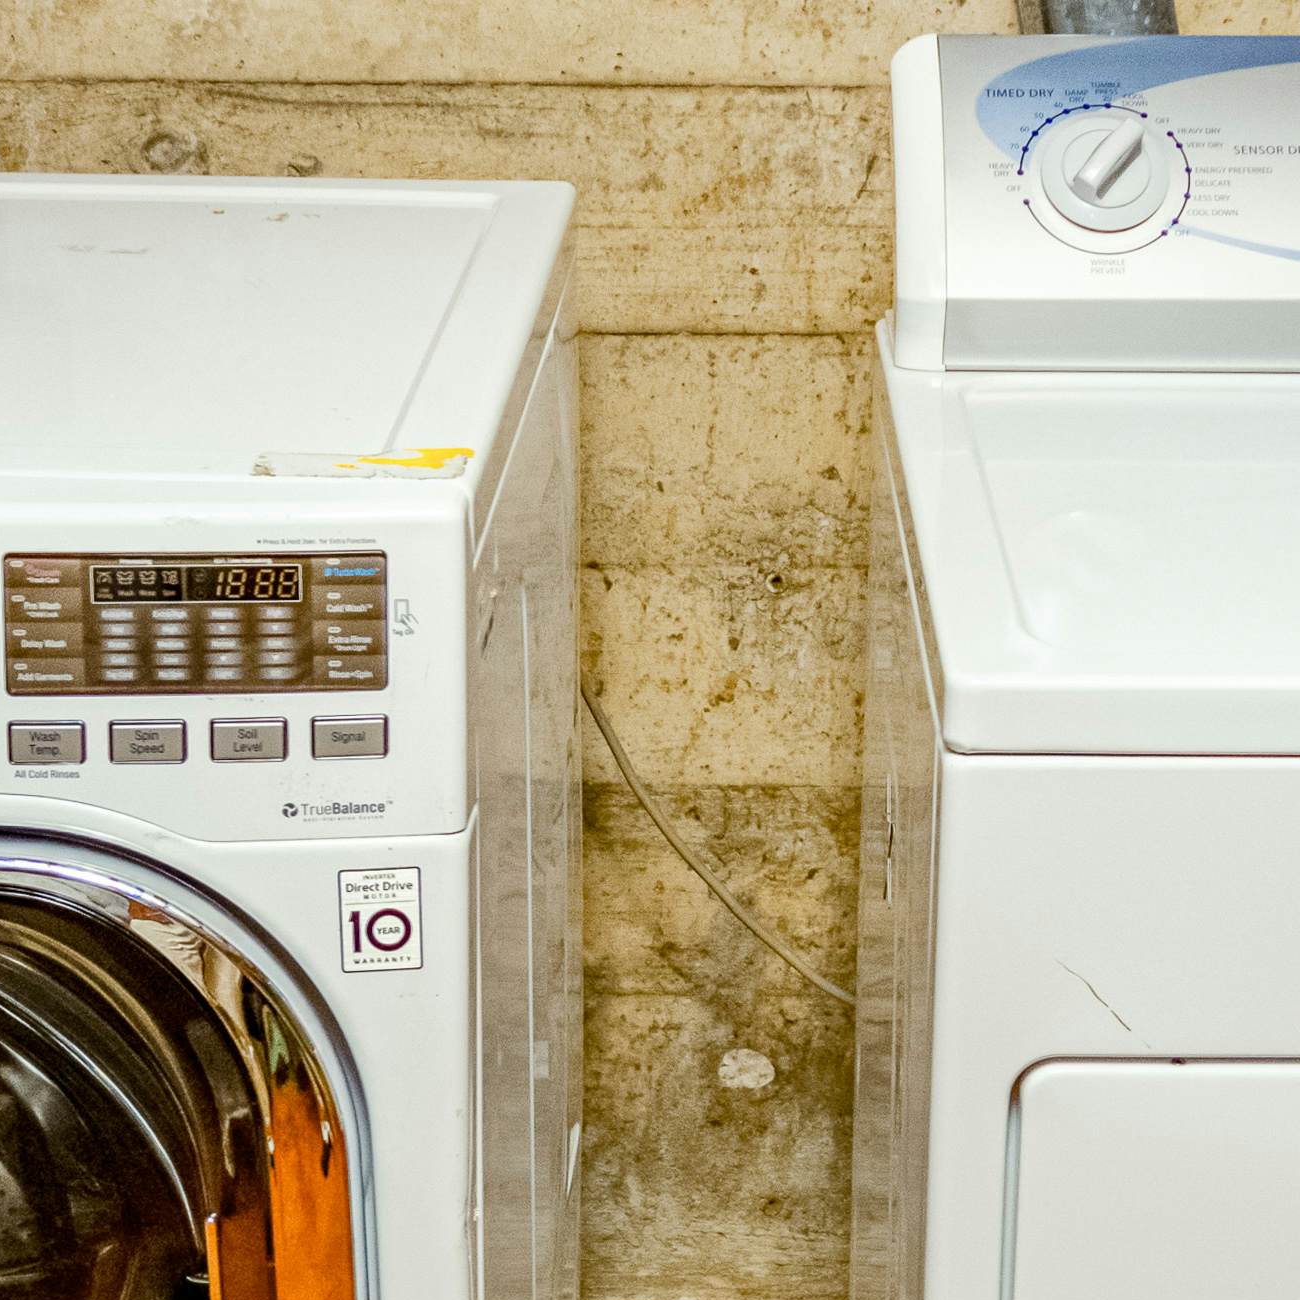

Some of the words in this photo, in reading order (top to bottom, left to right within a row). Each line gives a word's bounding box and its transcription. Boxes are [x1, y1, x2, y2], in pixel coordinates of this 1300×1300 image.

[986, 88, 1025, 98] TIMED
[1029, 89, 1054, 98] DRY
[1234, 145, 1284, 155] SENSOR
[29, 731, 61, 742] Wash
[135, 730, 159, 742] Spin
[238, 729, 257, 740] Soil
[331, 731, 366, 743] Signal
[29, 744, 60, 756] Temp.
[130, 743, 165, 755] Speed
[233, 742, 263, 752] Level
[14, 770, 26, 778] All
[50, 770, 80, 778] Rinses
[346, 883, 379, 893] Direct
[383, 882, 413, 891] Drive
[349, 908, 412, 953] 10
[377, 927, 400, 935] YEAR
[354, 956, 411, 964] WARRANTY
